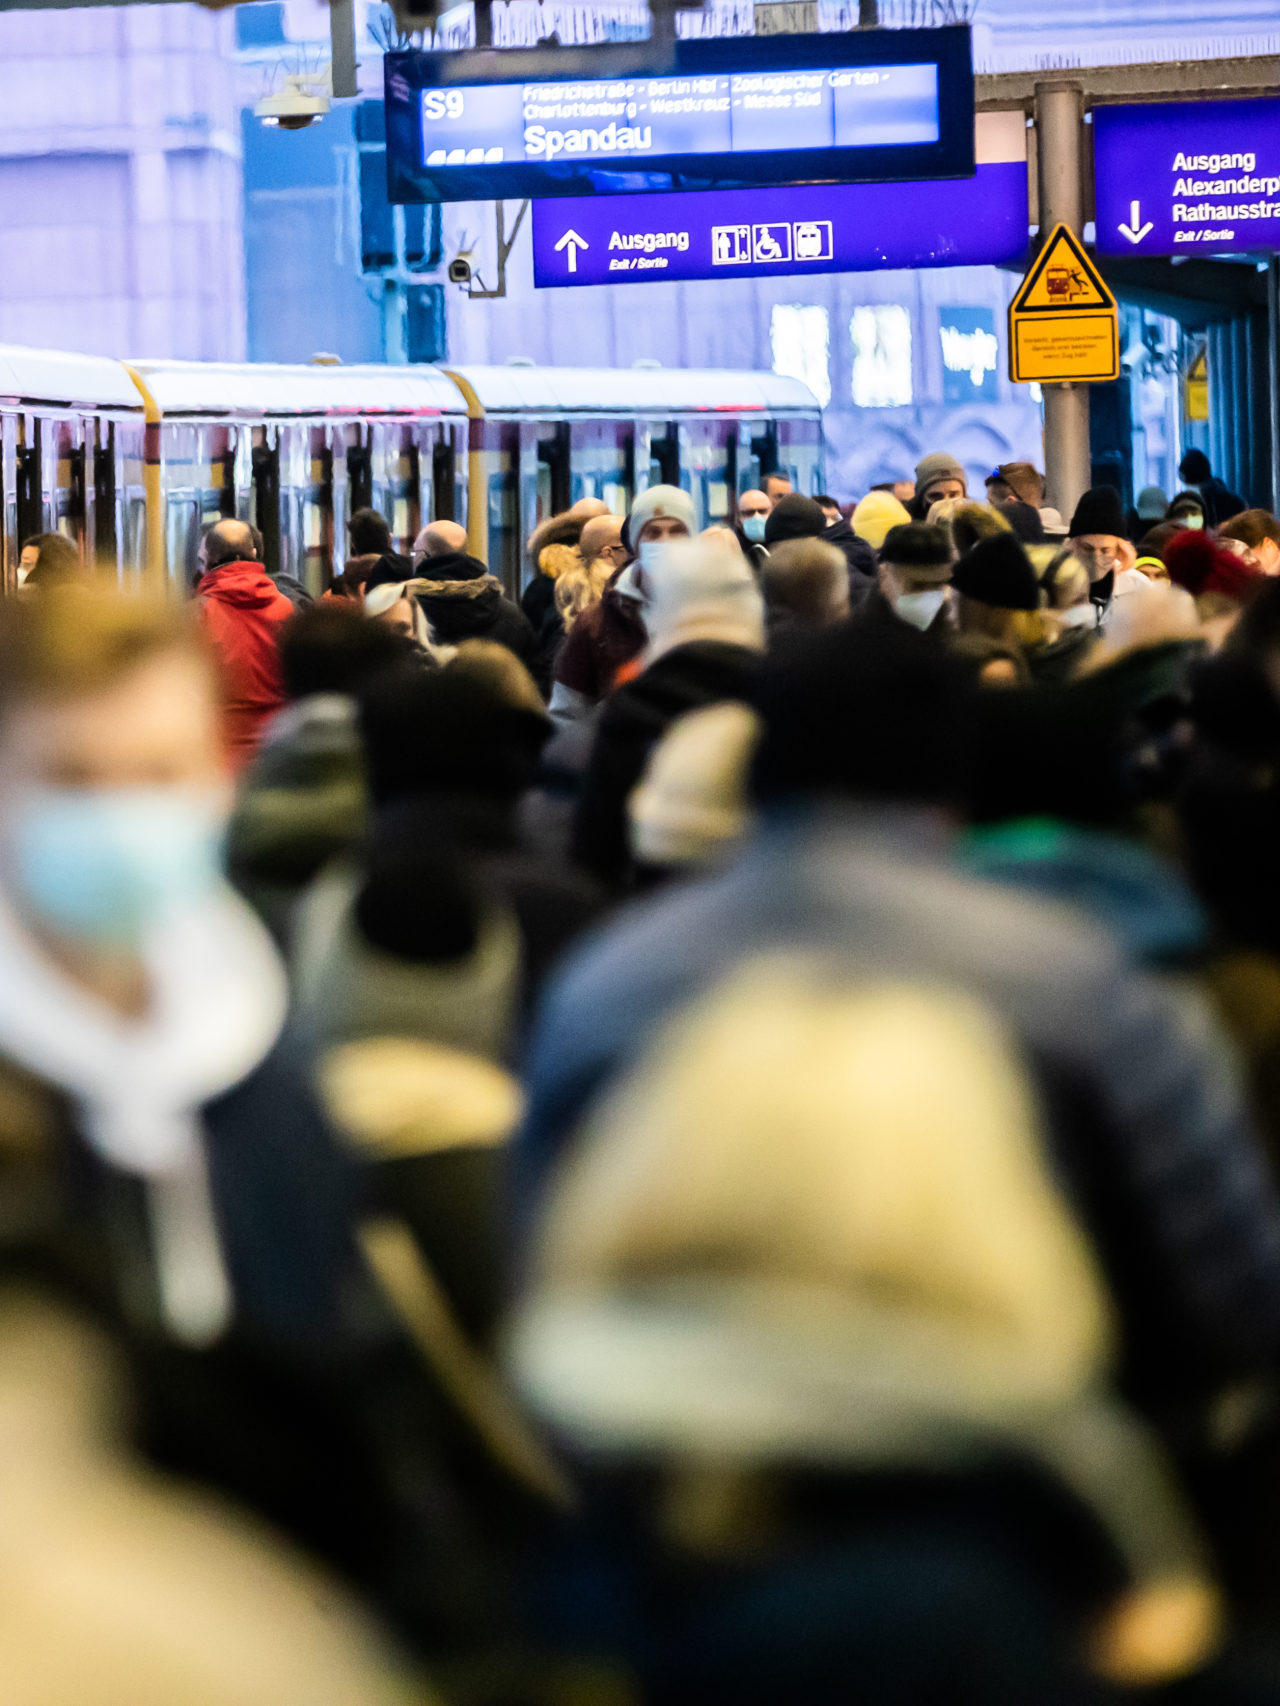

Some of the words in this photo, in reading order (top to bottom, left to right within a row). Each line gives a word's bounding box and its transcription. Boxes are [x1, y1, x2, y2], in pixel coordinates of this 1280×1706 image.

[522, 82, 635, 103] Friedrichstraße
[648, 80, 690, 97] Berlin
[692, 78, 718, 94] Hbf
[732, 74, 825, 94] Zoologischer
[828, 71, 880, 88] Garten
[424, 89, 464, 120] S9
[523, 101, 637, 120] Charlottenburg
[649, 97, 731, 113] Westkreuz
[743, 94, 793, 110] Messe
[794, 91, 822, 107] Süd
[523, 121, 652, 161] Spandau
[1172, 152, 1256, 174] Ausgang
[1172, 175, 1280, 196] Alexanderp
[608, 231, 689, 253] Ausgang
[1173, 230, 1195, 243] Exit
[1202, 228, 1235, 242] Sortie
[637, 256, 669, 270] Sortie
